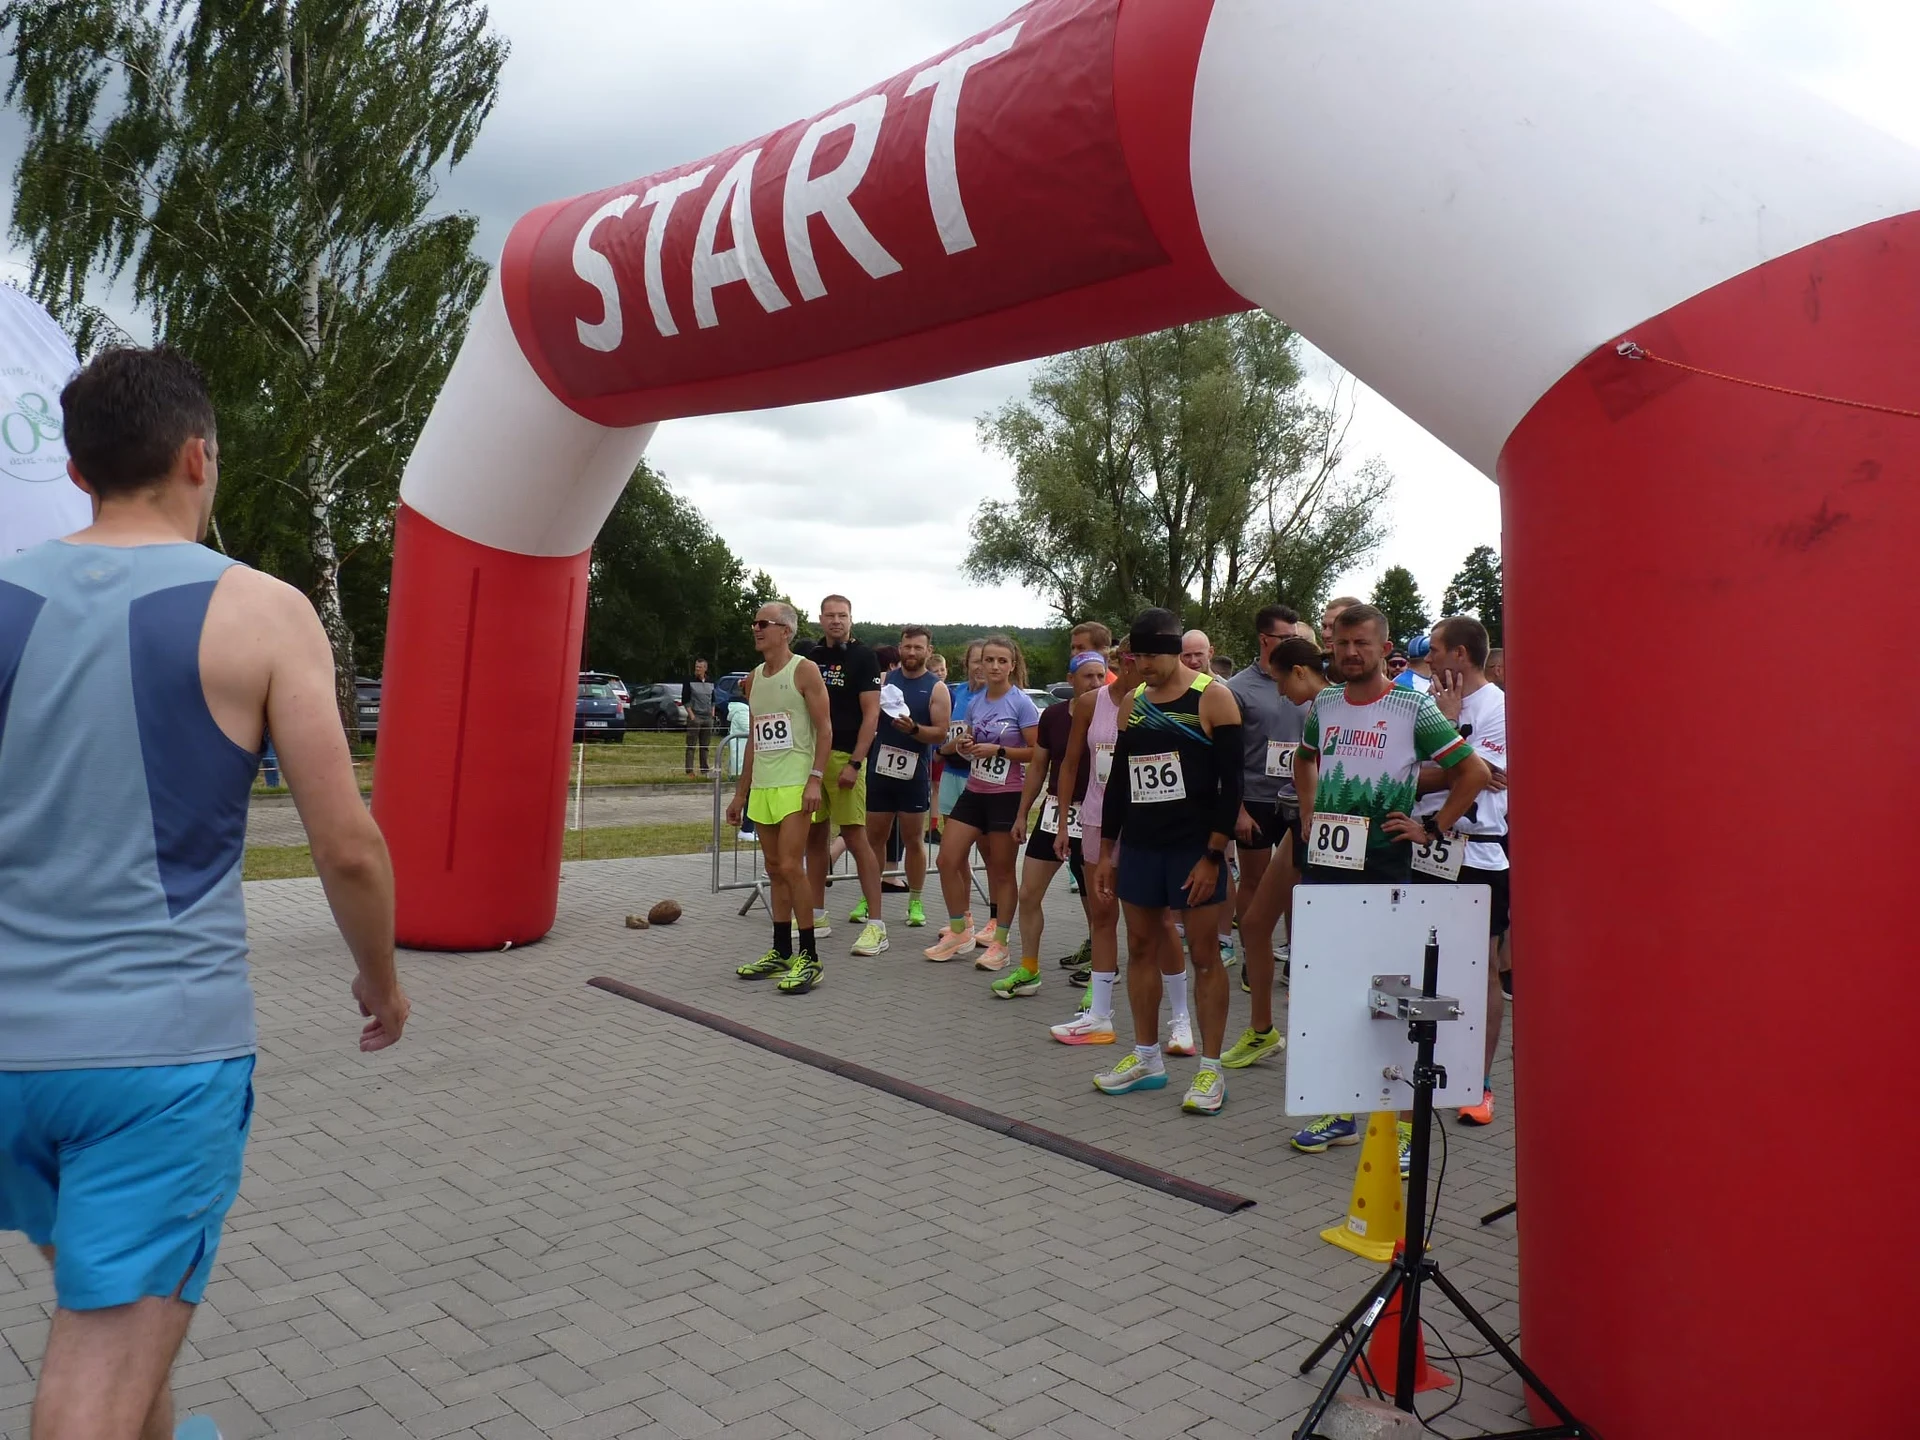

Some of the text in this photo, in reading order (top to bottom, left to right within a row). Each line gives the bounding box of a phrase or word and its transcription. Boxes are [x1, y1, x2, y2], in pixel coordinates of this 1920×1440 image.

[572, 21, 1026, 352] START
[755, 720, 788, 741] 168
[1338, 728, 1387, 749] JURUND
[887, 753, 908, 770] 19
[1335, 745, 1384, 760] SZCZYTNO
[975, 755, 1006, 775] 148
[1133, 762, 1178, 790] 136
[1317, 823, 1350, 853] 80
